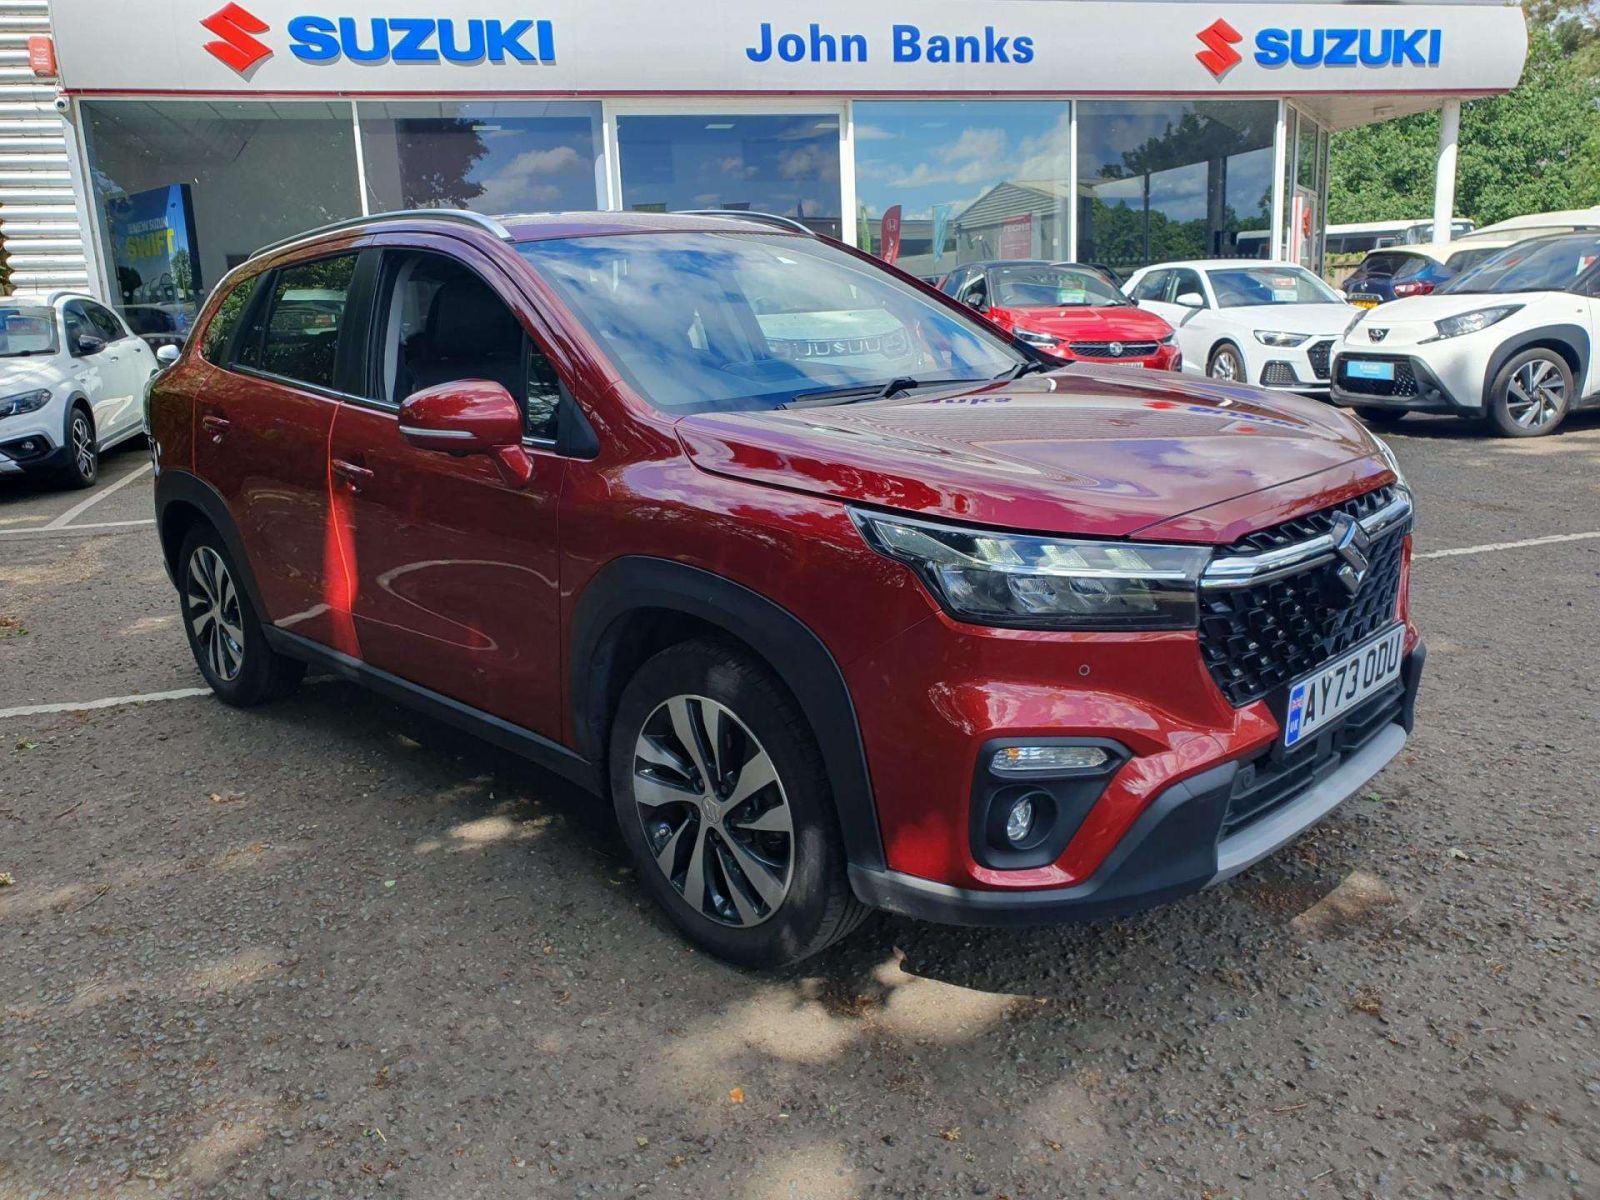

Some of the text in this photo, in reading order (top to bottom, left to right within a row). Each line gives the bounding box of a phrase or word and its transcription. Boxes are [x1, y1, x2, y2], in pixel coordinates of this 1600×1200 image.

[288, 16, 555, 62] SUZUKI
[746, 23, 1034, 64] John Banks
[1254, 28, 1441, 67] SUZUKI
[128, 228, 174, 258] SWIFT
[1303, 634, 1400, 727] AY73 ODU
